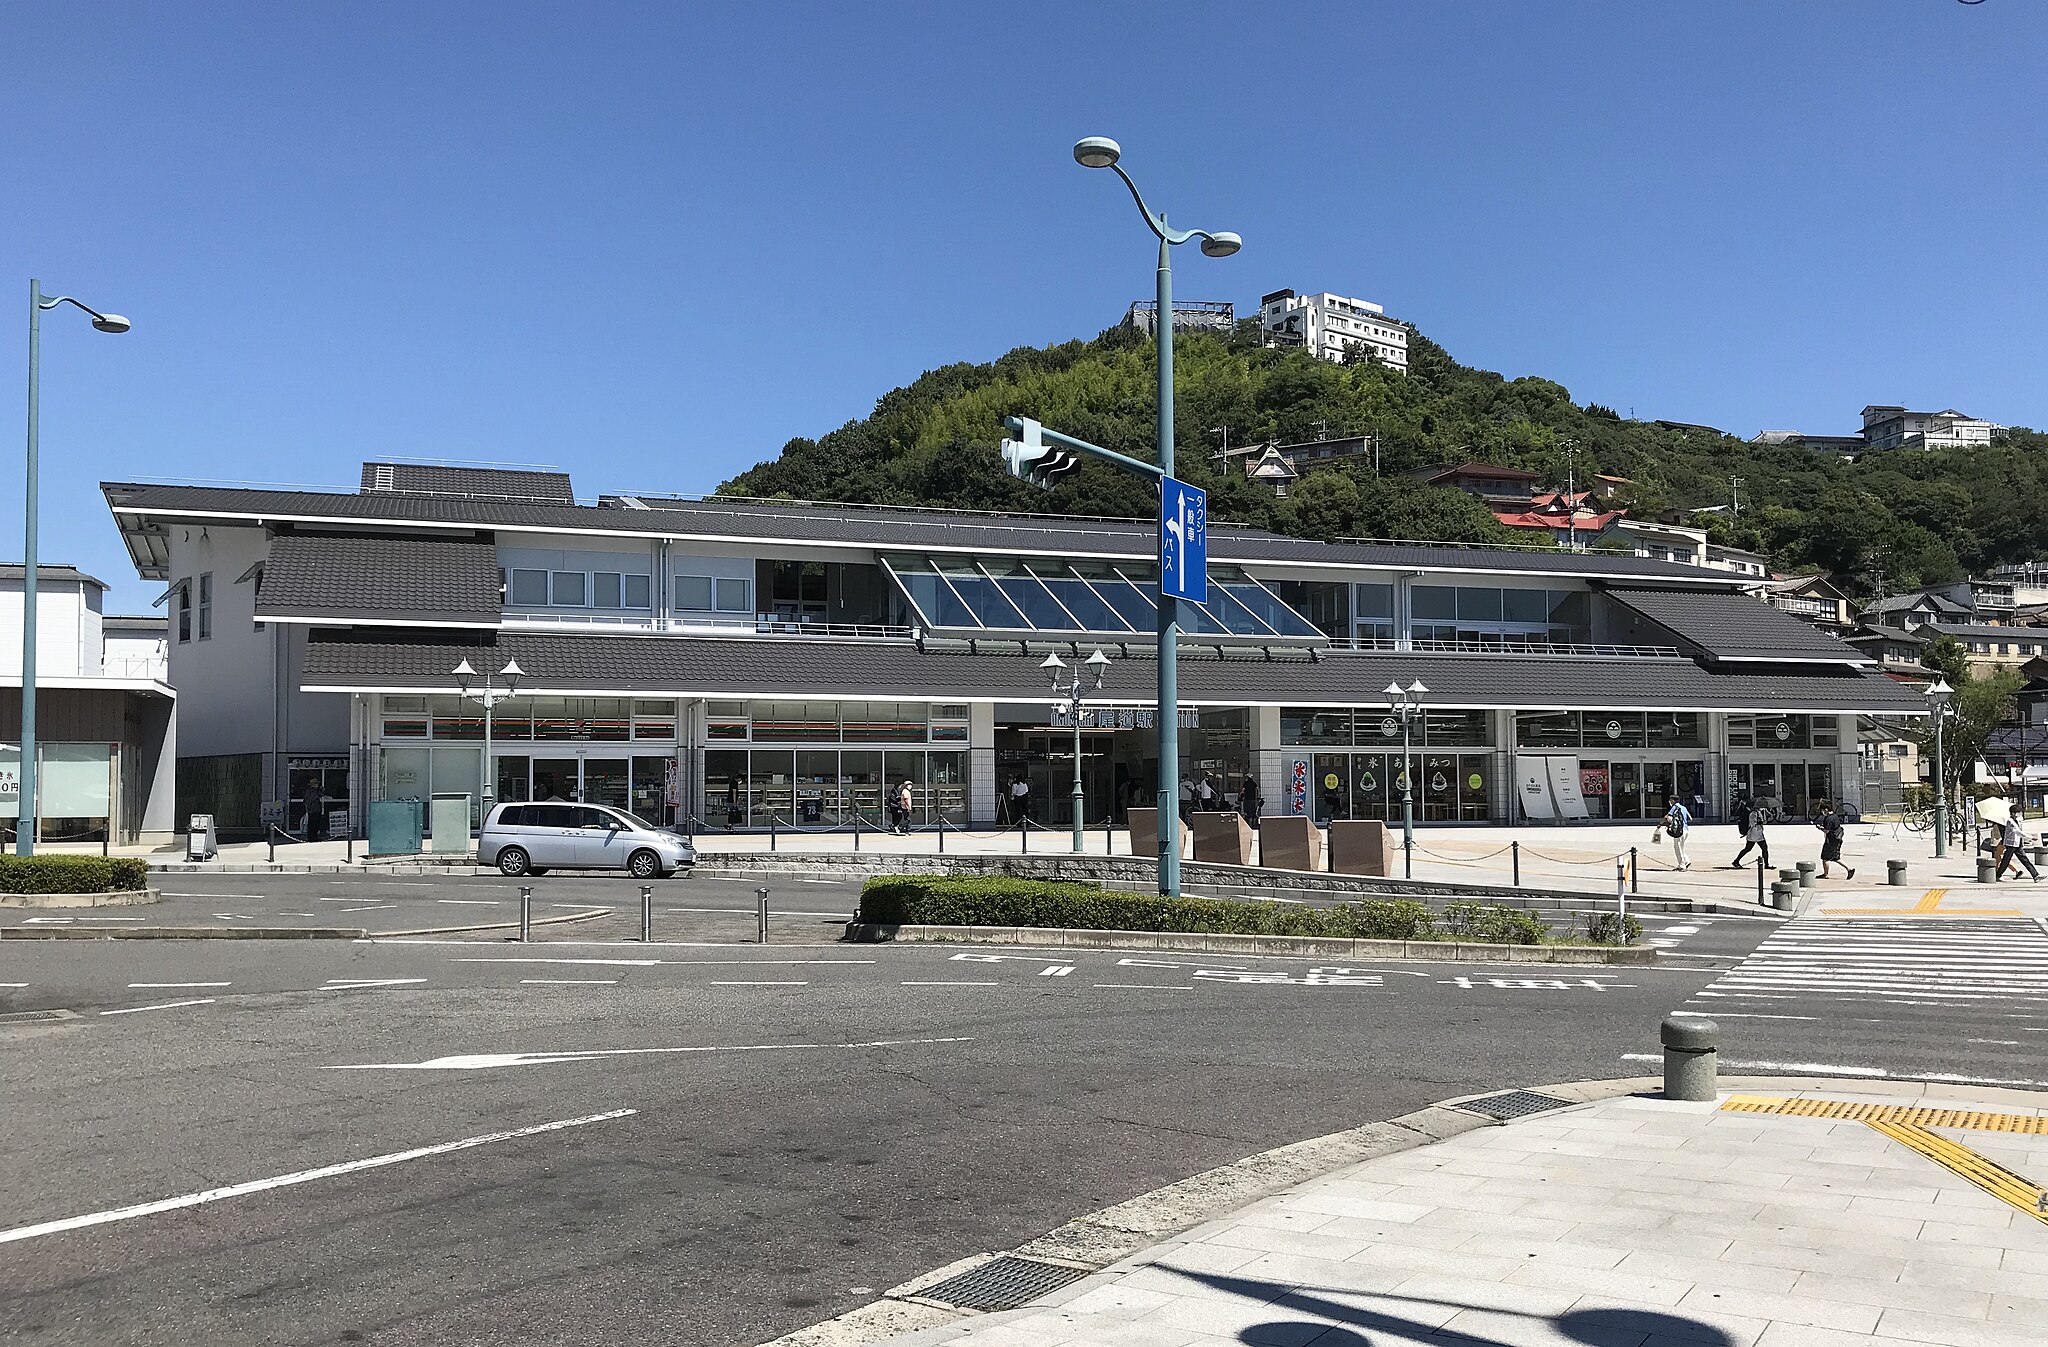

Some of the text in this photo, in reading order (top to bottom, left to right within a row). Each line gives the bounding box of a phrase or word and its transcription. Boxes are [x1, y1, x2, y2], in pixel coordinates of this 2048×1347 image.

[1187, 496, 1195, 543] 一般車
[1196, 495, 1204, 547] タクシー
[1164, 537, 1174, 572] バス
[1099, 711, 1153, 729] 尾道駅
